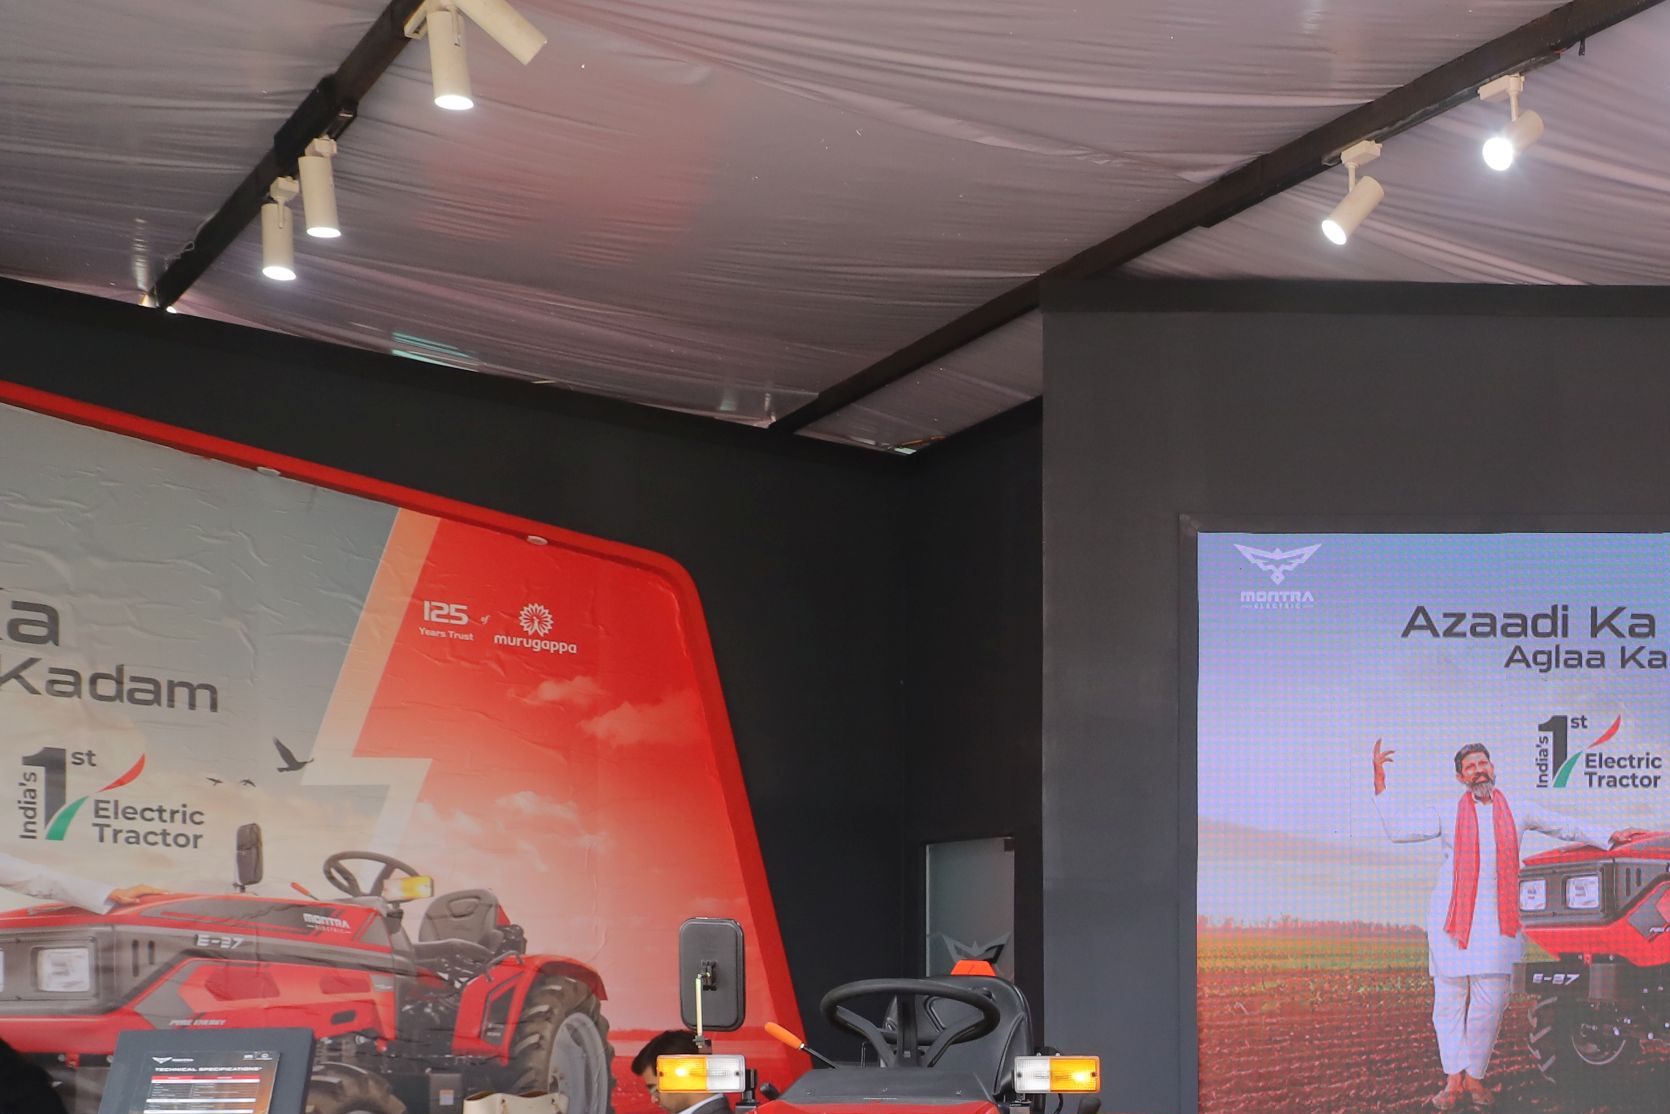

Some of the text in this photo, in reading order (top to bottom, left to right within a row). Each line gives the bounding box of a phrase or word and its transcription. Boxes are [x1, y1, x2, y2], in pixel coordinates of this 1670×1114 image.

[1240, 591, 1314, 602] MONTRA
[423, 600, 470, 625] 125
[1400, 603, 1656, 639] Azaadi Ka
[418, 626, 475, 641] Years Trust
[494, 634, 578, 654] murugappa
[1503, 644, 1606, 673] Aglaa
[0, 657, 219, 713] Kadam
[1535, 735, 1549, 789] India's
[1584, 751, 1663, 769] Electric
[1583, 771, 1662, 788] Tractor
[18, 771, 38, 840] India's
[93, 799, 205, 826] Electric
[91, 822, 204, 849] Tractor
[196, 934, 244, 949] E-27
[1532, 973, 1580, 985] E-27
